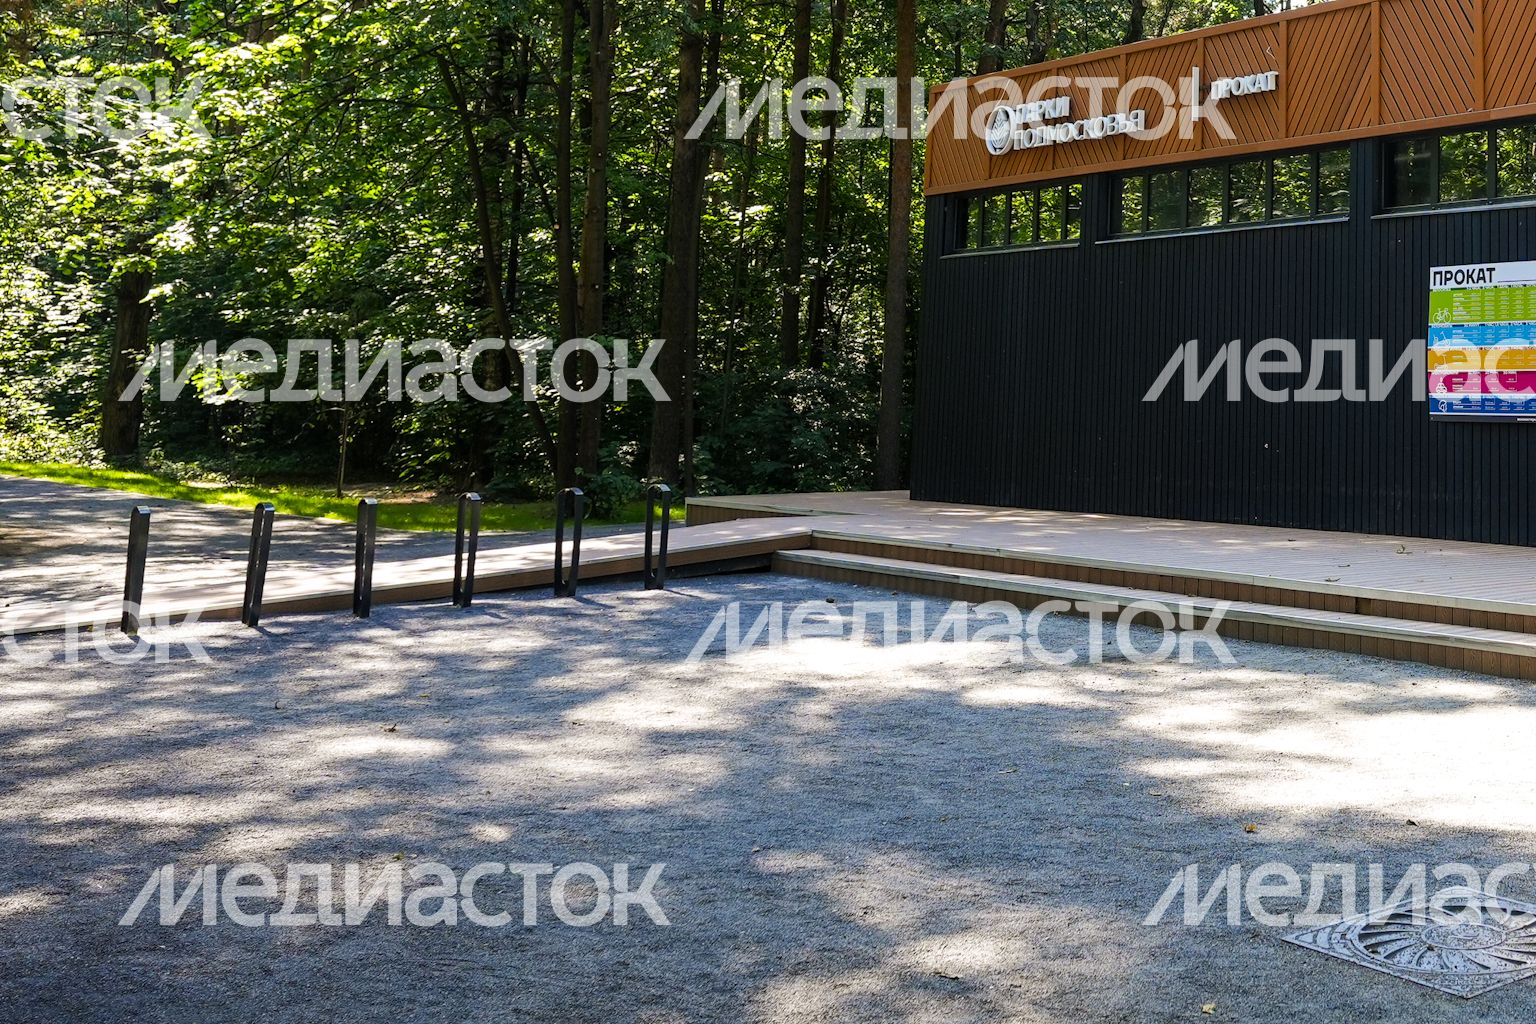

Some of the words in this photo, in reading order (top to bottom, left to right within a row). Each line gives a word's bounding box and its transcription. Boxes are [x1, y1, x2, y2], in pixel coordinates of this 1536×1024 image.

[1210, 70, 1279, 100] ПРОКАТ
[1015, 96, 1071, 124] ПАРКИ
[1014, 110, 1146, 150] ПОДМОСКОВЬЯ
[1432, 267, 1496, 287] ПРОКАТ
